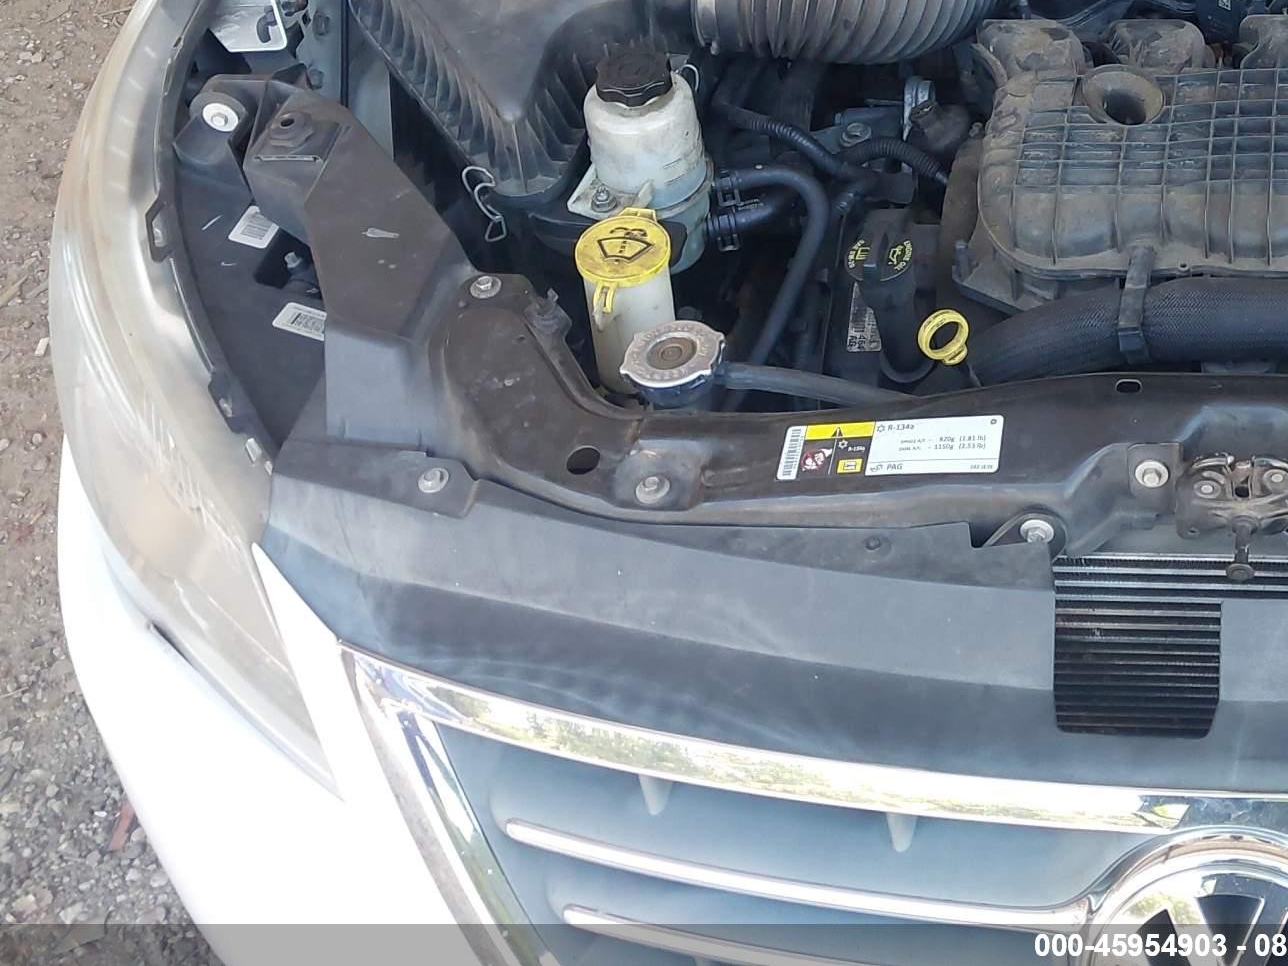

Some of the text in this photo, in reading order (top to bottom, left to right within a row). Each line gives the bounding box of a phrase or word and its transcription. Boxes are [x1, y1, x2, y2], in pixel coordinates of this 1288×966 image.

[903, 240, 912, 261] ENGINE
[894, 261, 906, 271] OIL
[887, 423, 915, 432] R-134a
[886, 463, 903, 471] PAG
